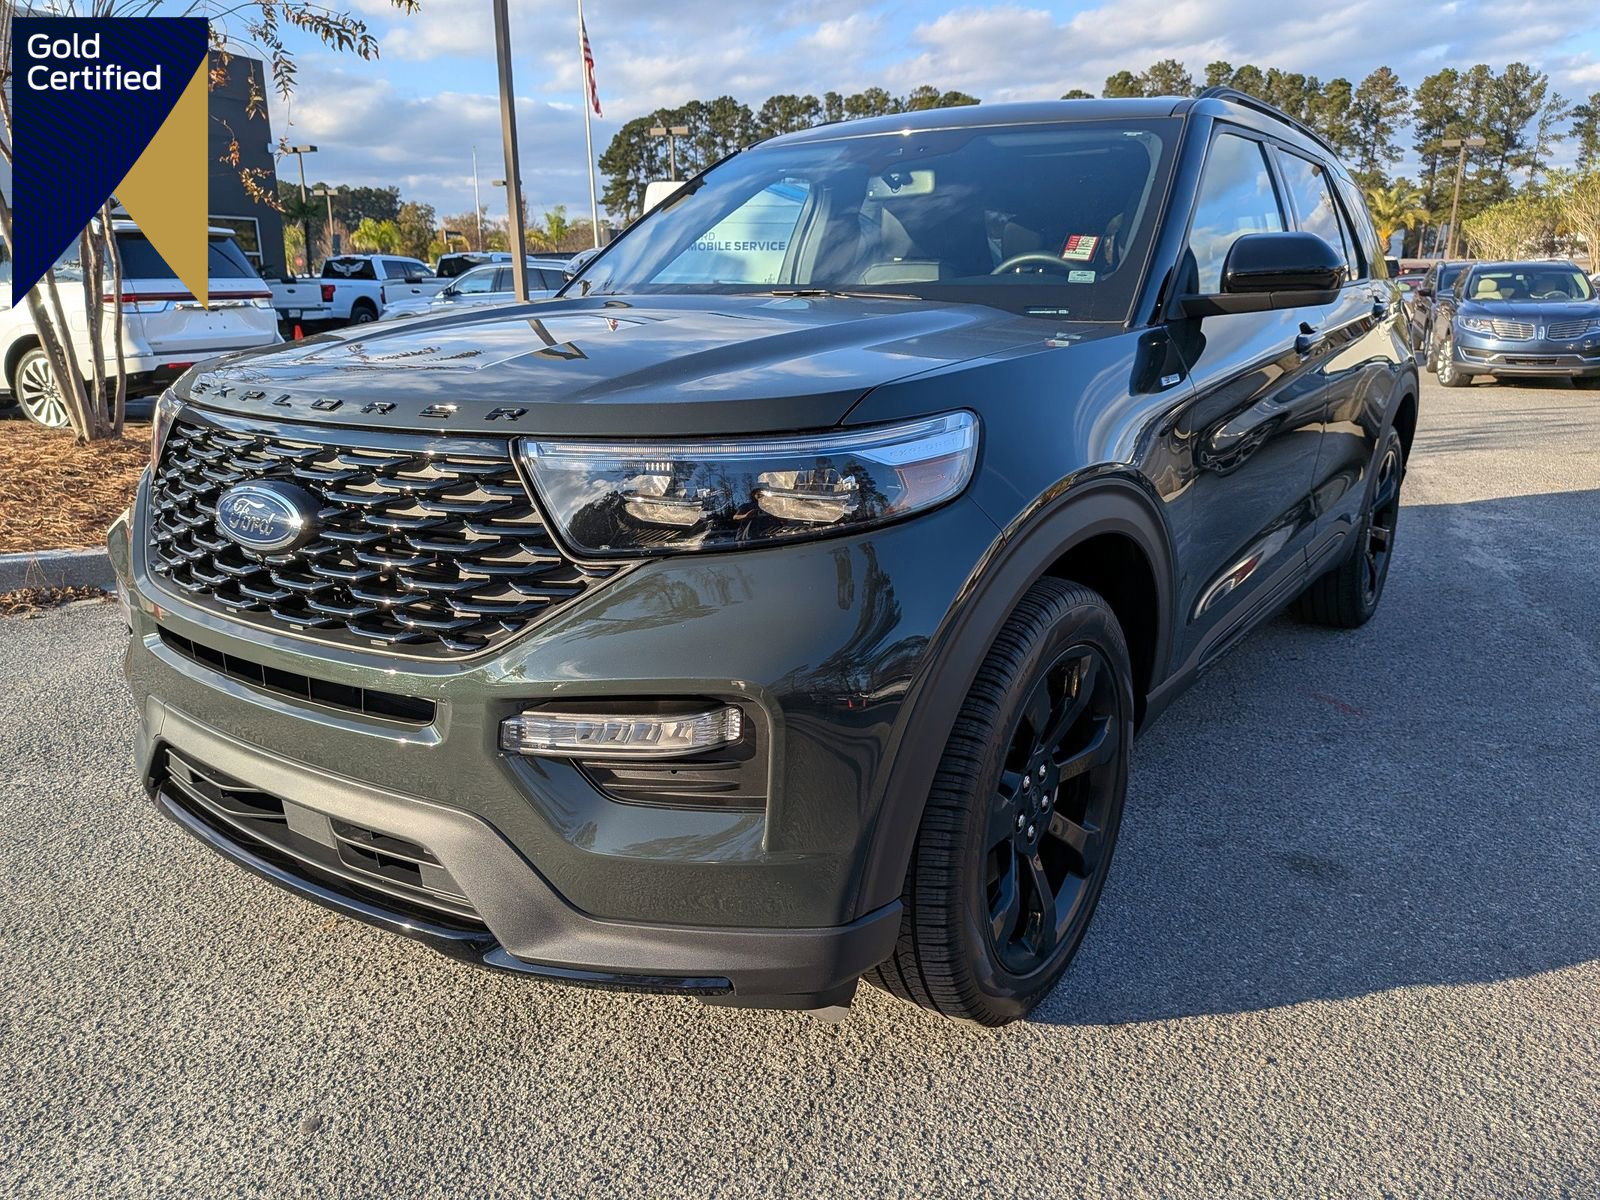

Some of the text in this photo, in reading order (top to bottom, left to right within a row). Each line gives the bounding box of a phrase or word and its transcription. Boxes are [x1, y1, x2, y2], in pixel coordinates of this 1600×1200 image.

[733, 241, 786, 251] SERVICE
[191, 382, 530, 421] EXPLORER
[228, 497, 277, 536] Ford
